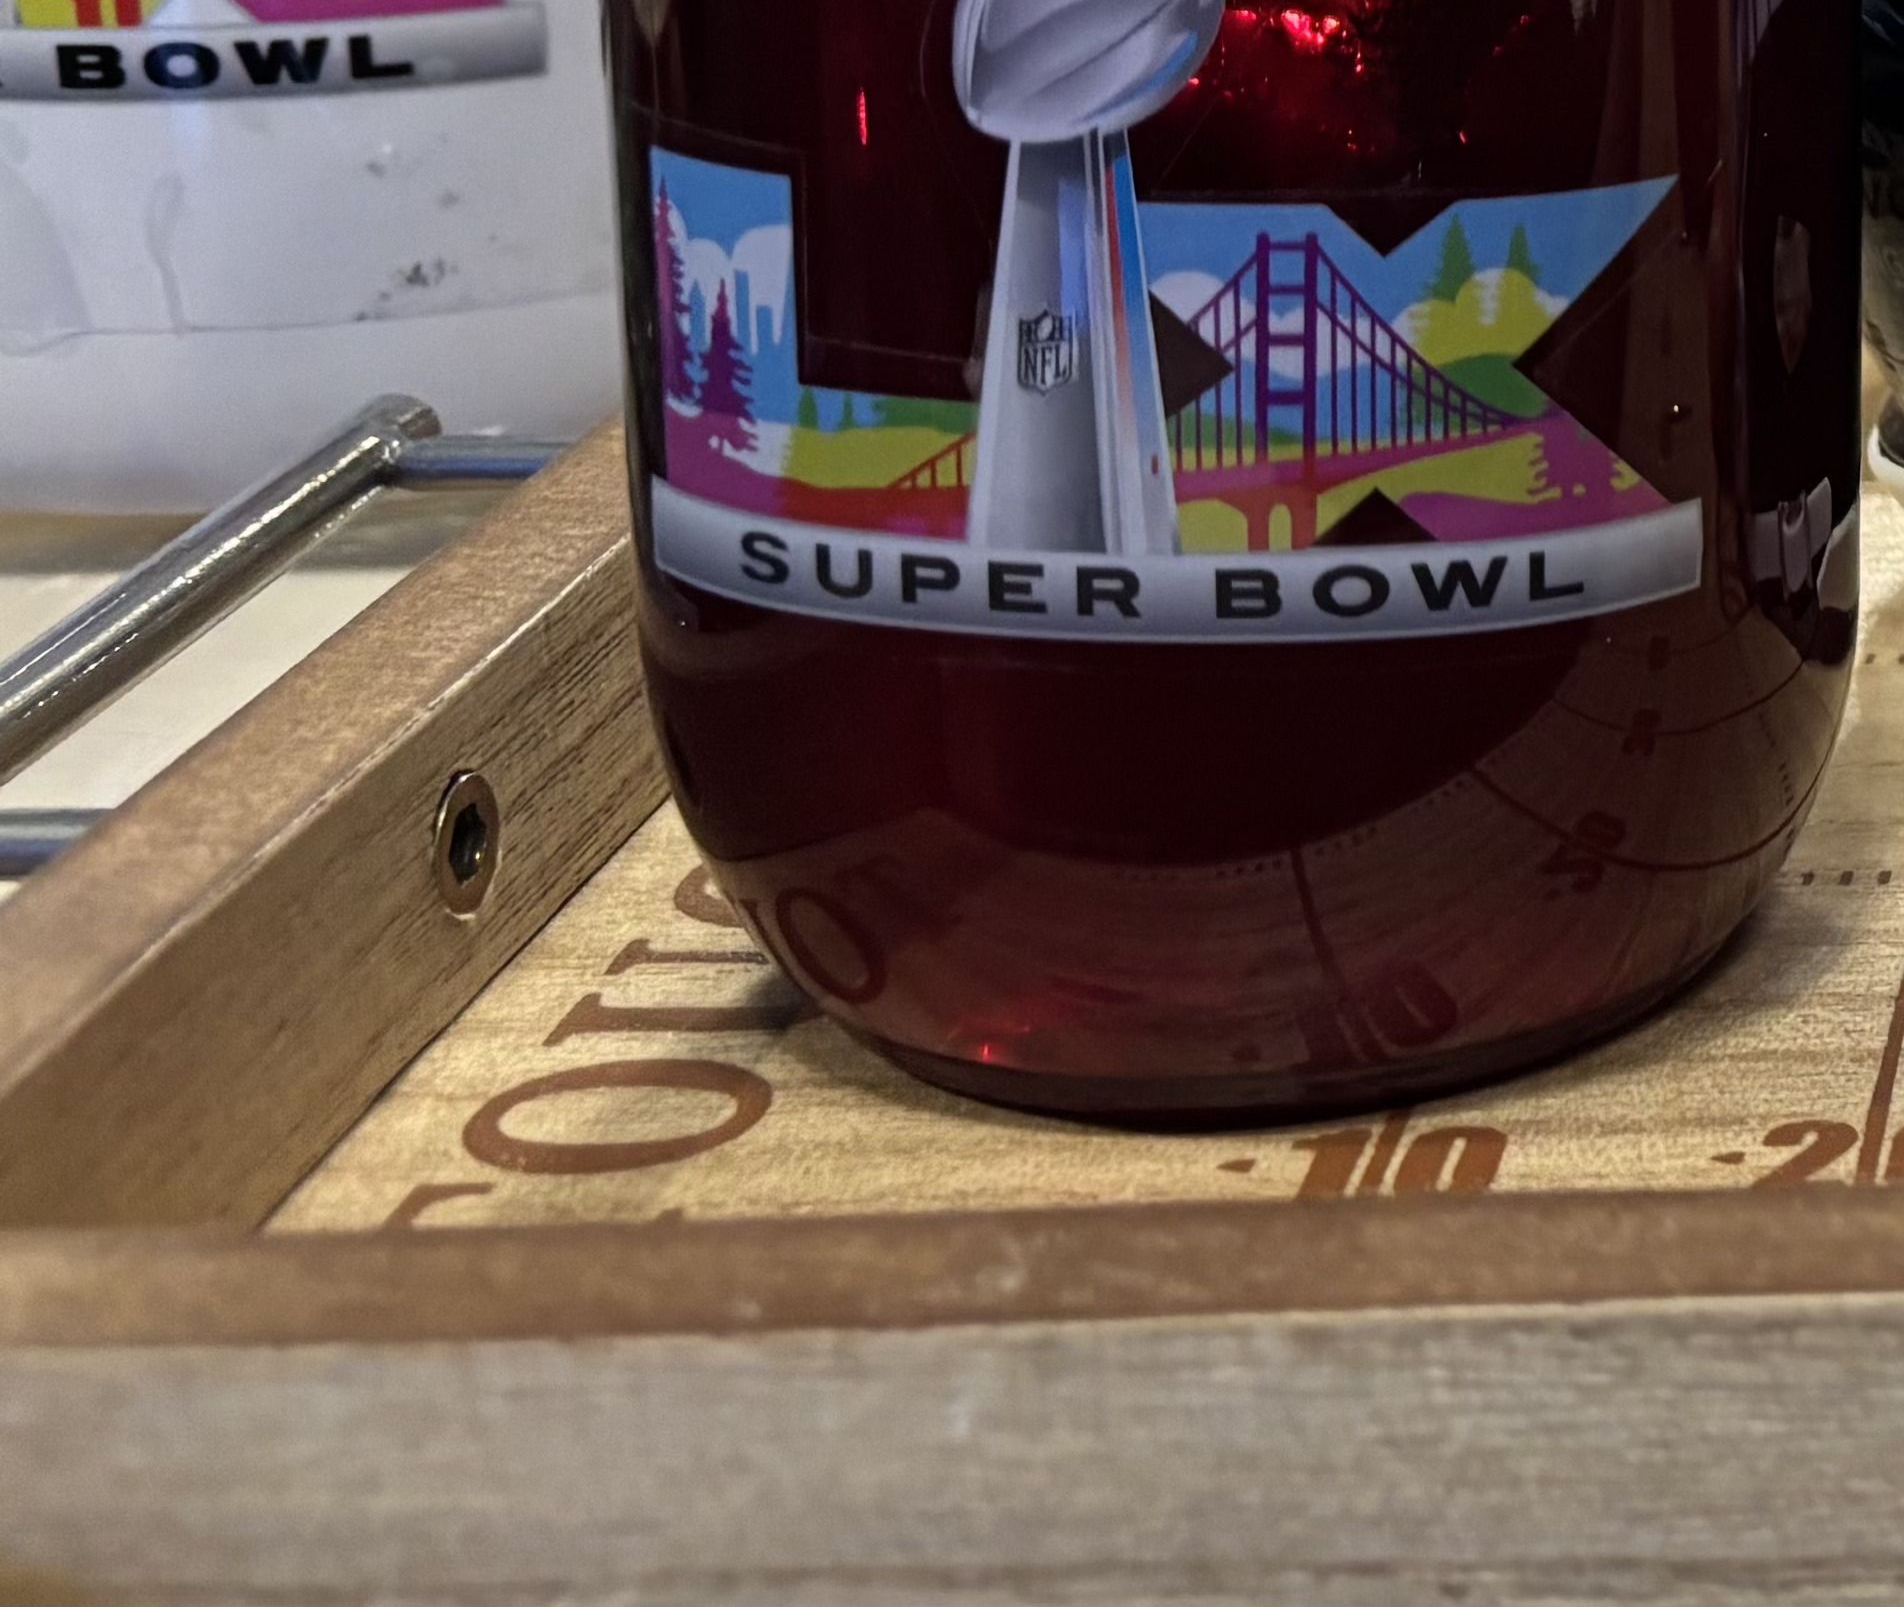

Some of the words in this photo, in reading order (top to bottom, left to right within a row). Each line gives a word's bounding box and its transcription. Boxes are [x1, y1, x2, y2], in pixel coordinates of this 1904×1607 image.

[55, 34, 415, 91] BOWL
[739, 530, 1143, 620] SUPER
[1214, 550, 1586, 620] BOWL
